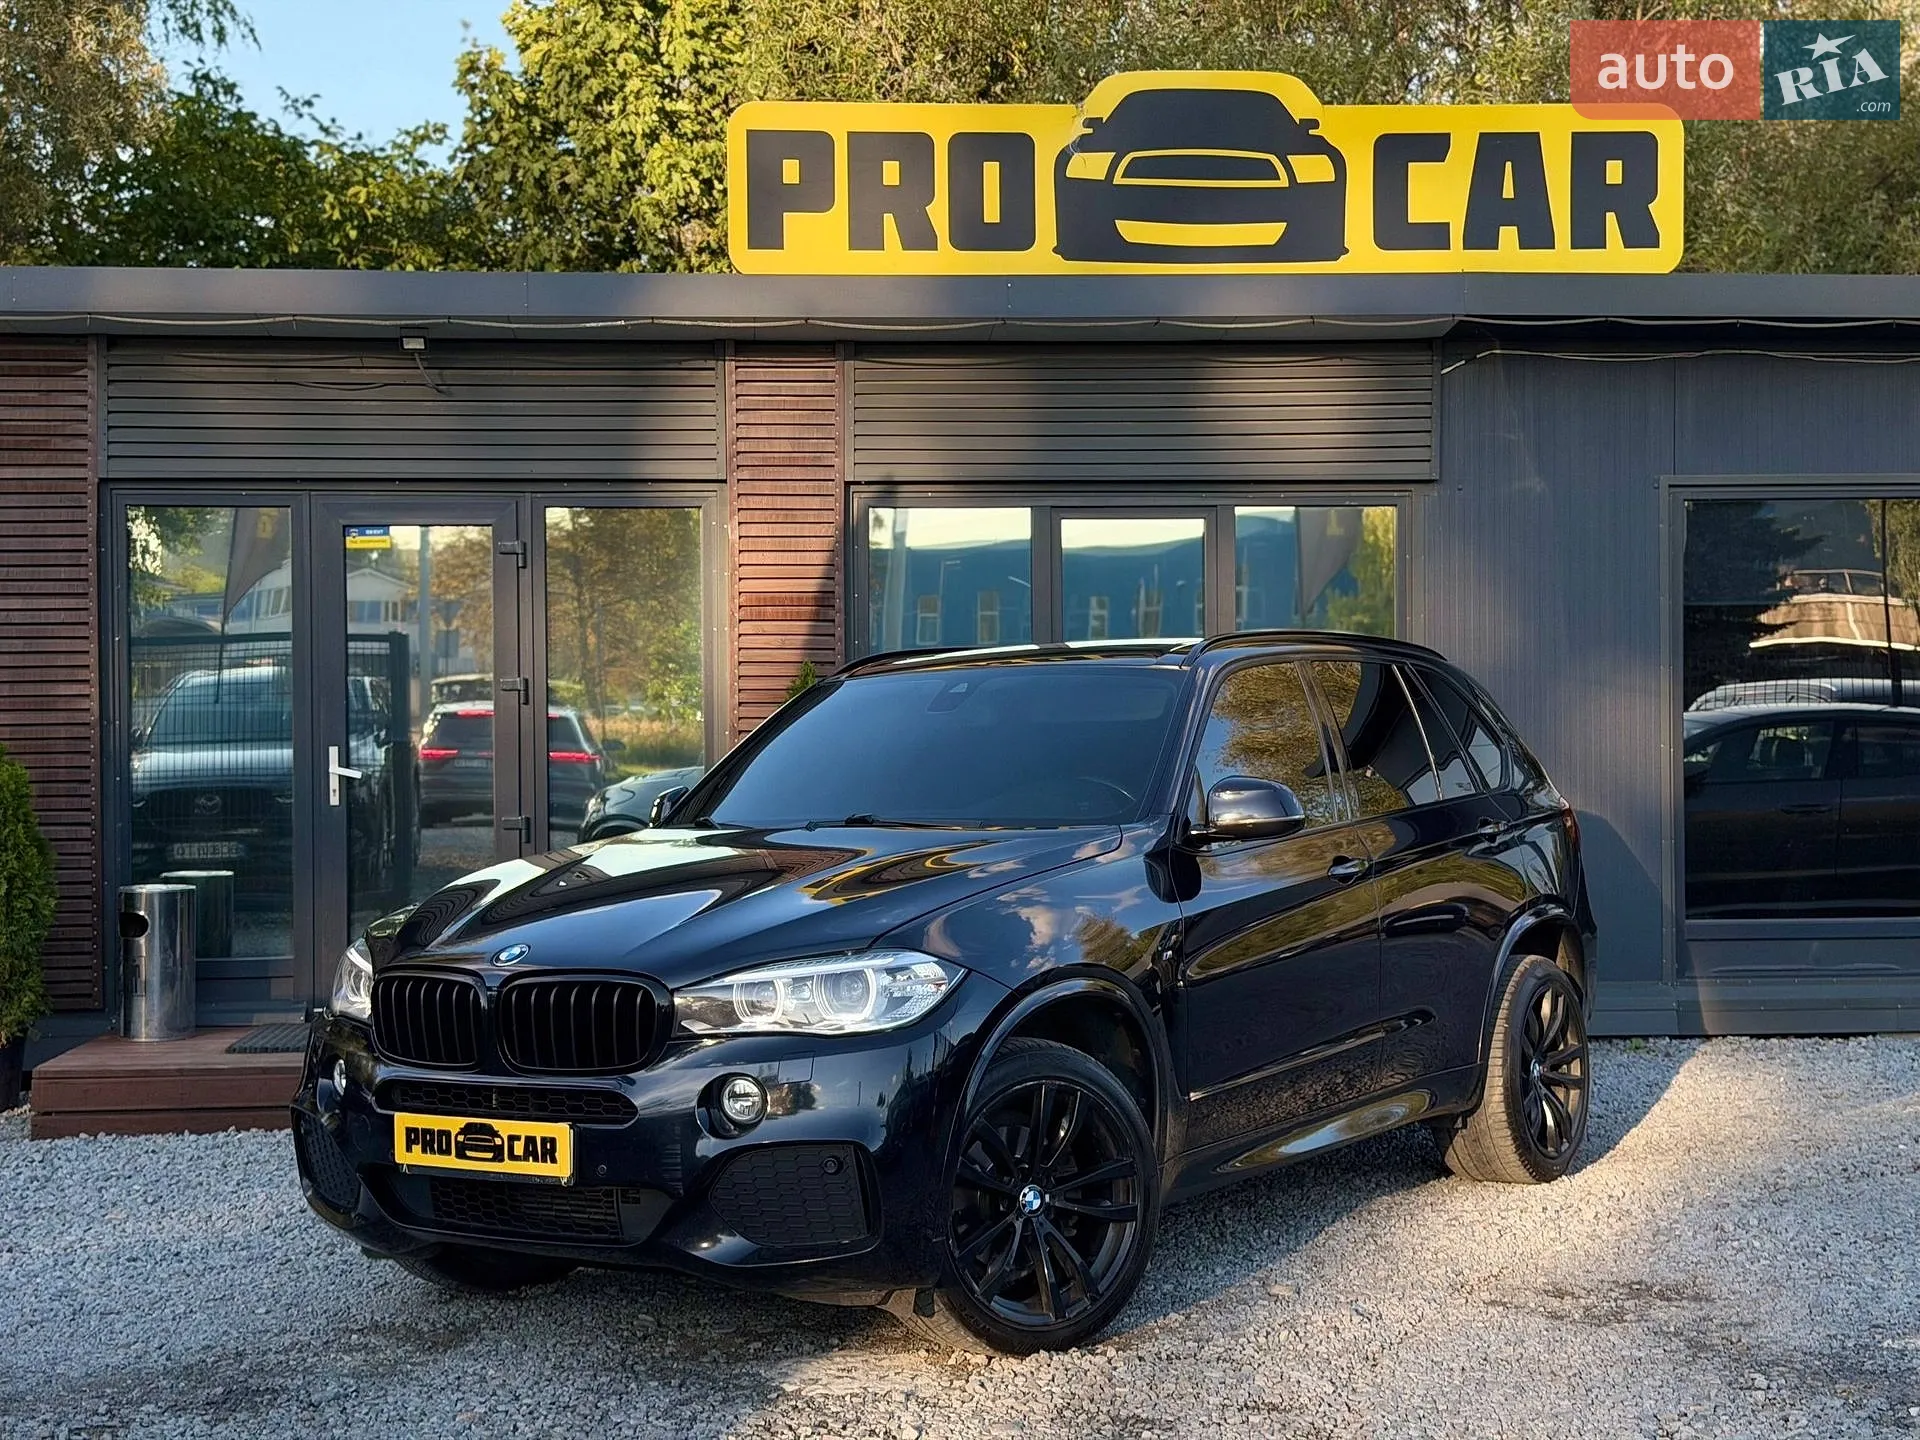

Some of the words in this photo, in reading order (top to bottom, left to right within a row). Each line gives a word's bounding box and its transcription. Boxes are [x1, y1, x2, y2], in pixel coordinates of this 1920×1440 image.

[746, 129, 1035, 251] PRO
[1372, 131, 1660, 251] CAR
[405, 1126, 453, 1157] PRO
[507, 1134, 558, 1164] CAR
